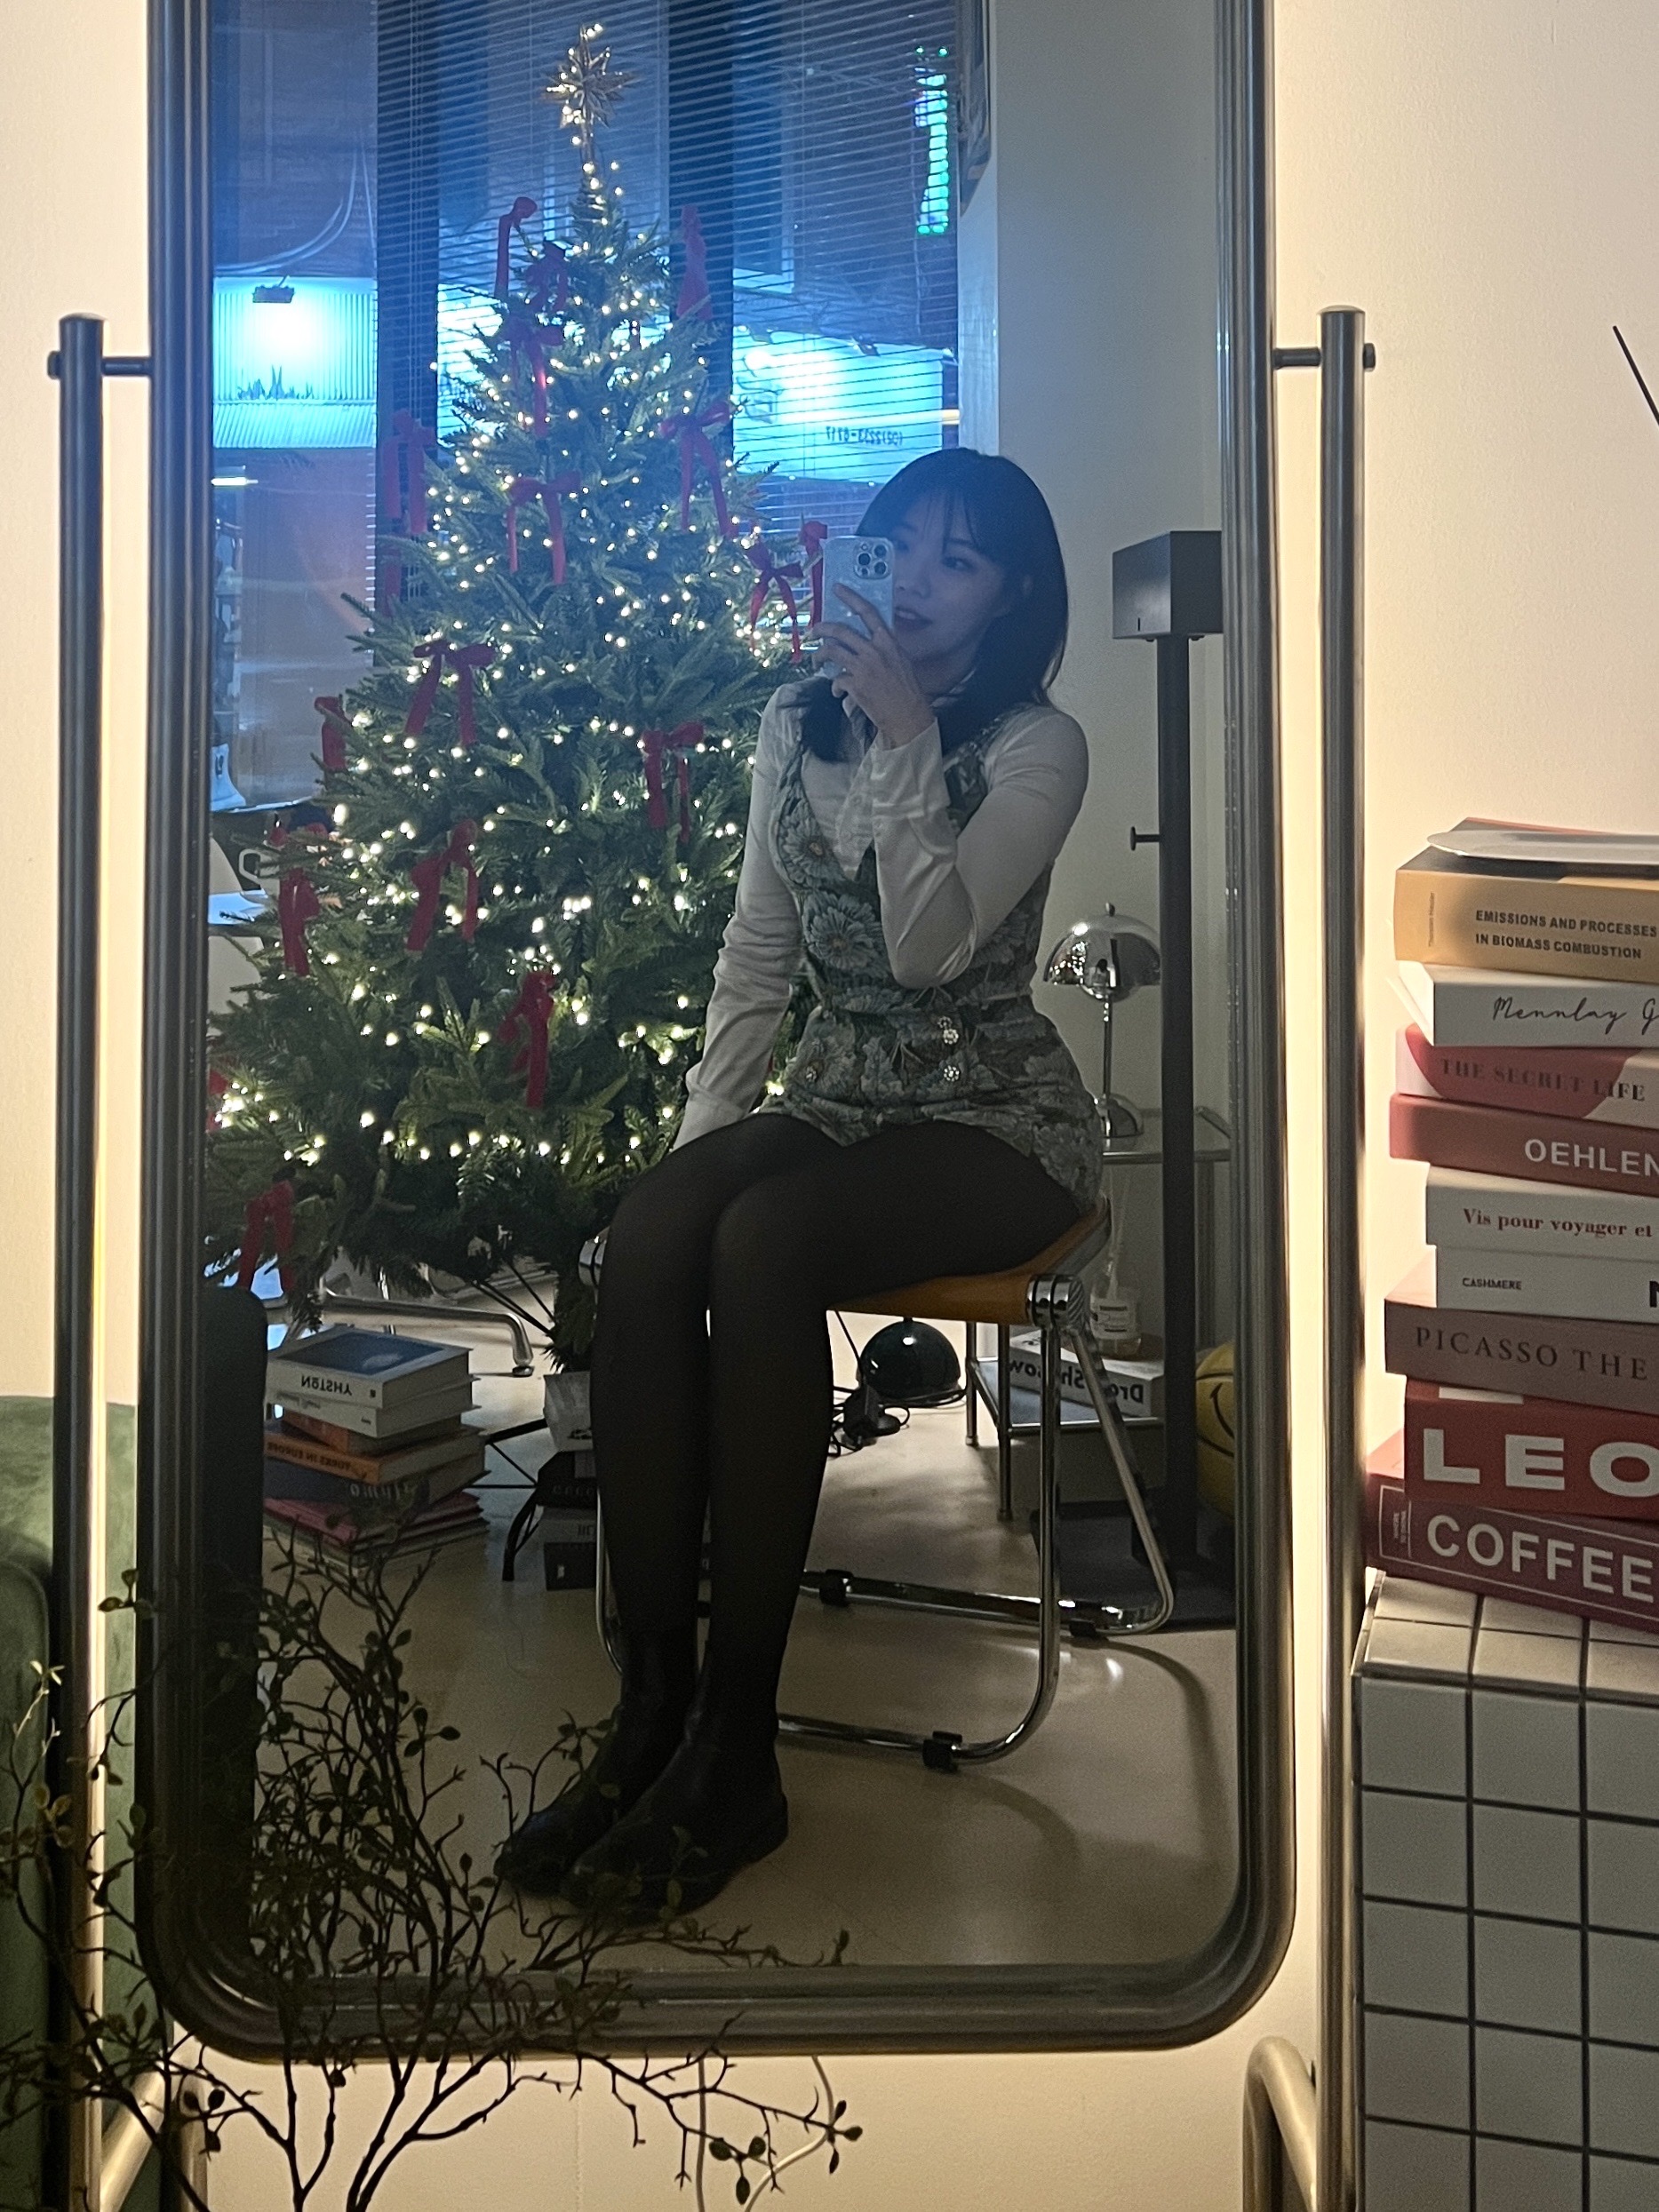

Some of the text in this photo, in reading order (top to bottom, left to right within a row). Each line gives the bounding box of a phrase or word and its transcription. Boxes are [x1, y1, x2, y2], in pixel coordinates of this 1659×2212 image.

[1475, 909, 1657, 938] EMISSIONS AND PROCESSES
[1475, 934, 1642, 959] IN BIOMASS COMBUSTION
[1441, 1058, 1646, 1102] THE SECRET LIFE
[1464, 1208, 1653, 1238] Vis pour voyager et
[1462, 1277, 1522, 1291] CASHMERE
[1416, 1326, 1648, 1381] PICASSO THE
[1427, 1514, 1654, 1603] COFFEE
